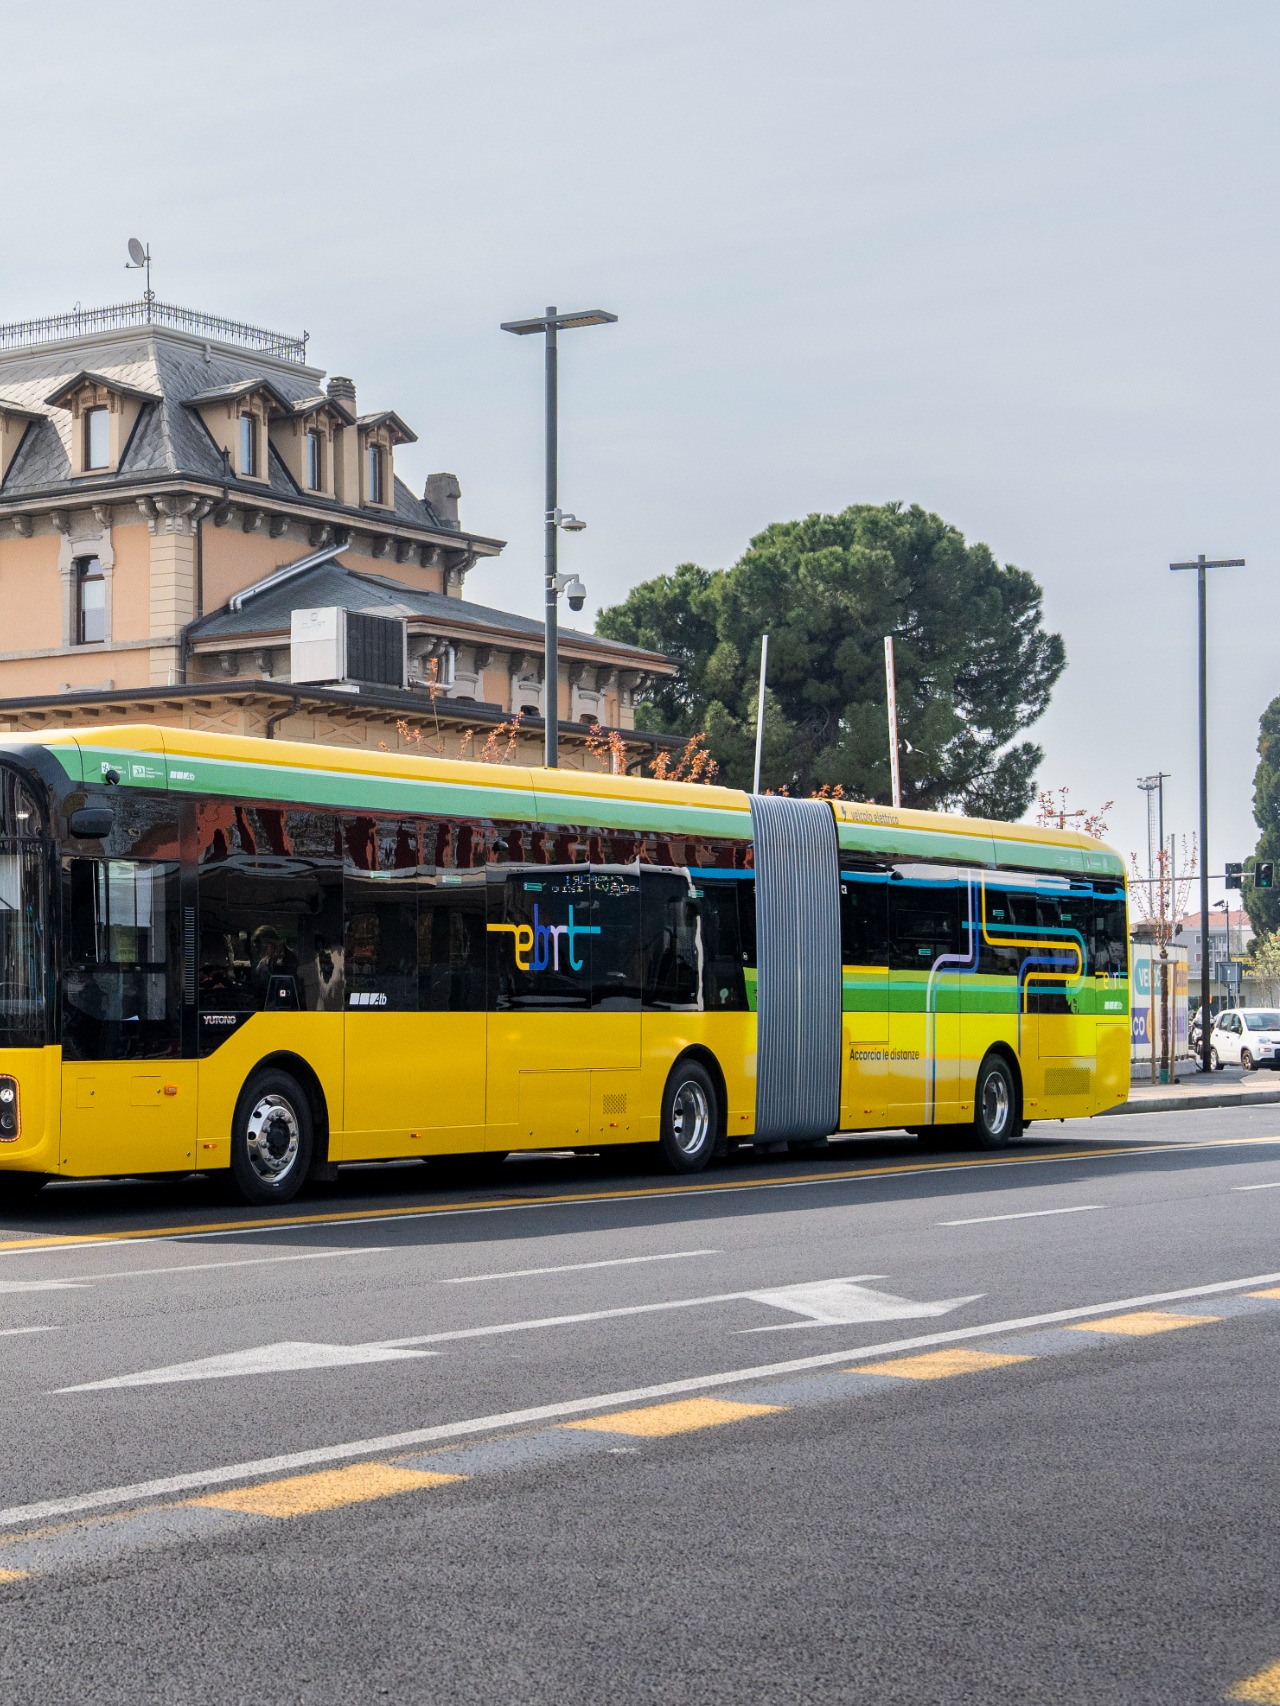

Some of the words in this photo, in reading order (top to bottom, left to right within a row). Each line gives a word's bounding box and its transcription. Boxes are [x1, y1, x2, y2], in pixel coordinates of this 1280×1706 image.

[851, 809, 873, 822] veicolo
[873, 811, 899, 824] elettrico
[487, 903, 601, 971] ebrt
[203, 1015, 237, 1025] YUTONG
[849, 1047, 881, 1060] Accorcia
[882, 1048, 889, 1060] le
[890, 1048, 920, 1060] distanze
